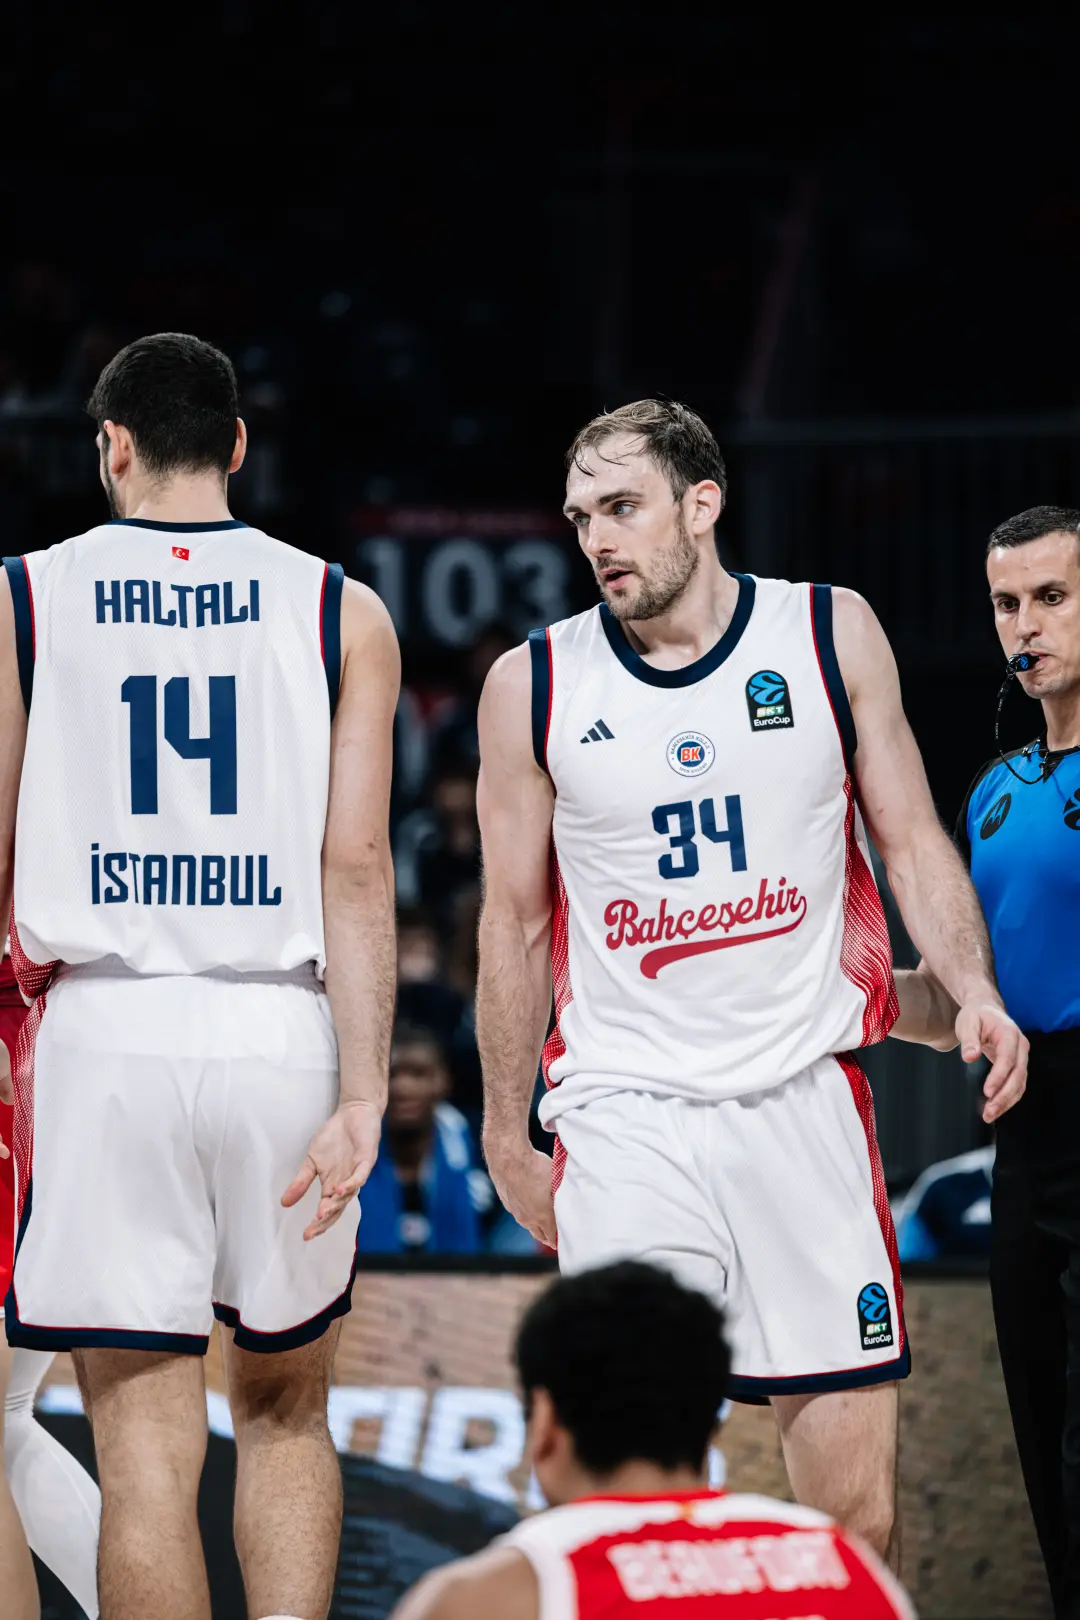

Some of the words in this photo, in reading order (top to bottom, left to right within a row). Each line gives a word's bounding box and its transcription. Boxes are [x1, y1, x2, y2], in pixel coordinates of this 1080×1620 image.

[95, 579, 260, 628] HALTALI
[355, 536, 568, 648] 103
[121, 675, 238, 815] 14
[753, 716, 791, 727] EuroCup
[681, 746, 702, 762] BK
[651, 794, 748, 880] 34
[91, 842, 282, 906] İSTANBUL
[604, 876, 807, 951] Bahçeşehir
[863, 1334, 892, 1346] EuroCup
